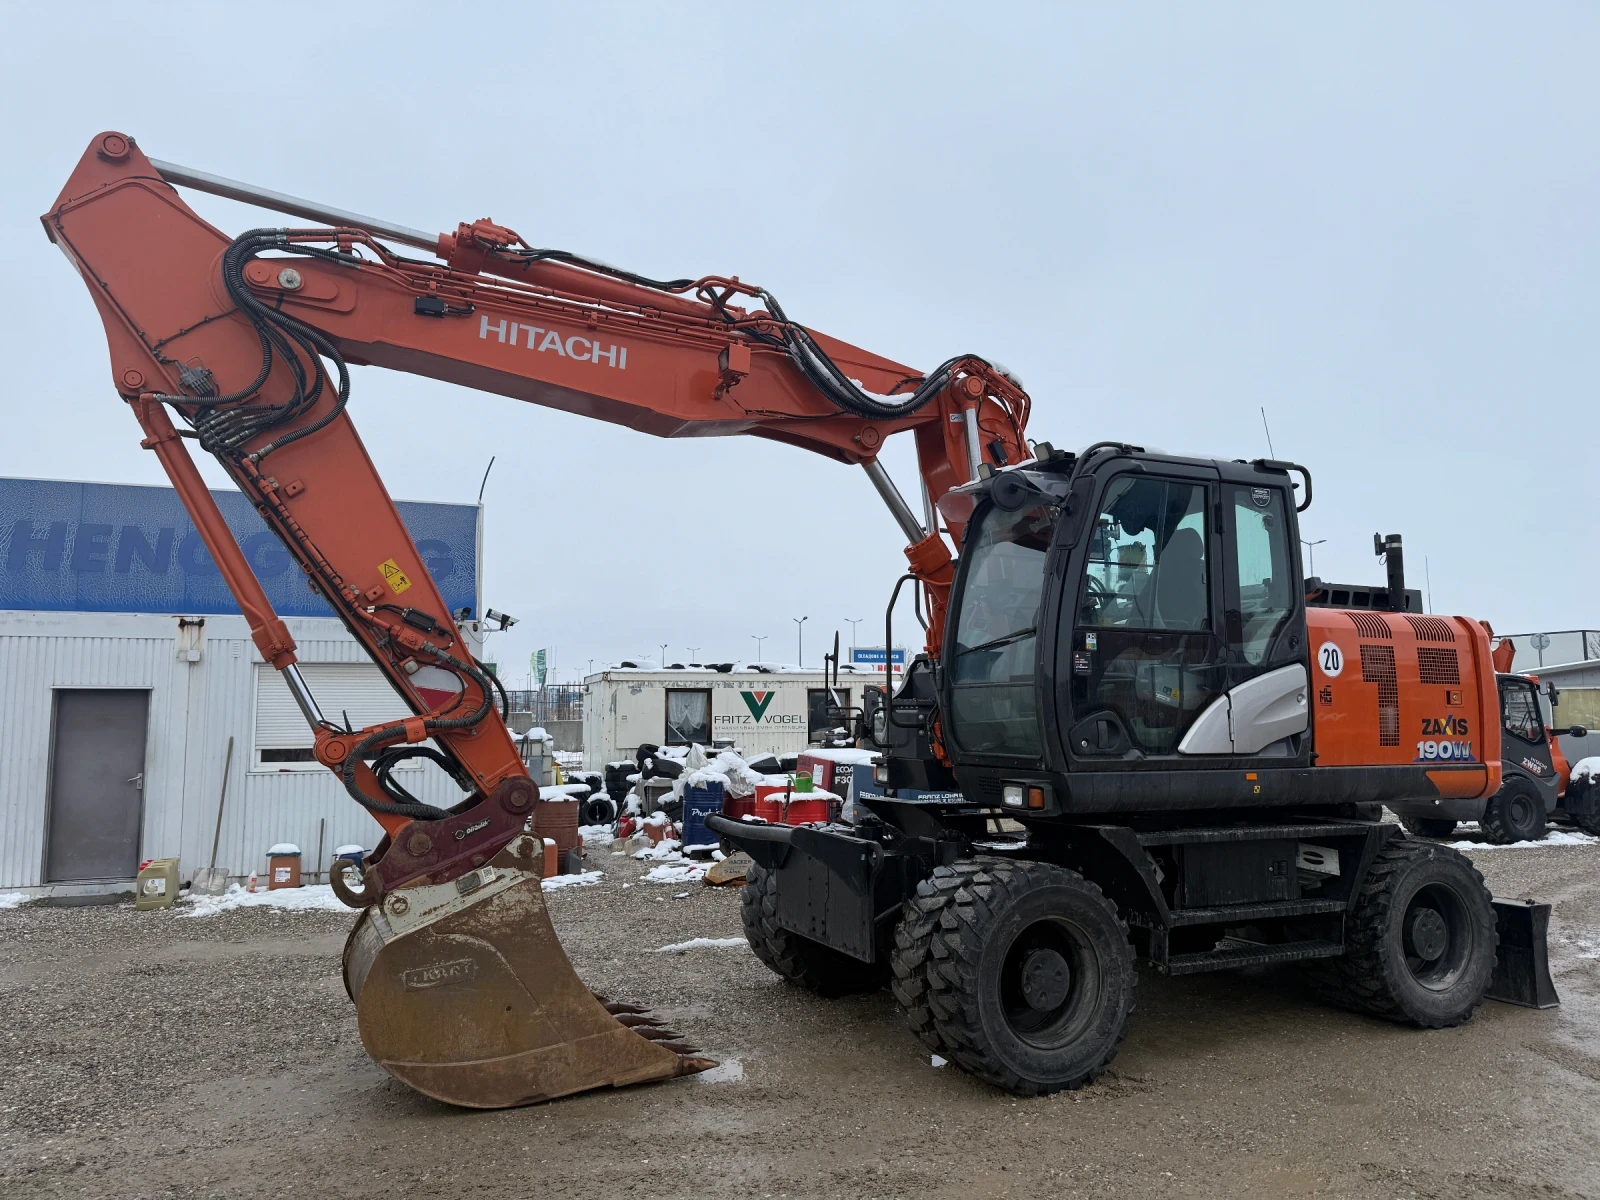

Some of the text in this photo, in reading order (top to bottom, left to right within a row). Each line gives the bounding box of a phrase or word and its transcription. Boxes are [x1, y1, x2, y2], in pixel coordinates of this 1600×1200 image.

[479, 315, 627, 370] HITACHI
[1323, 648, 1339, 670] 20
[714, 714, 806, 724] FRITZ VOGEL
[1422, 714, 1468, 735] ZAXIS
[1417, 741, 1472, 760] 190W
